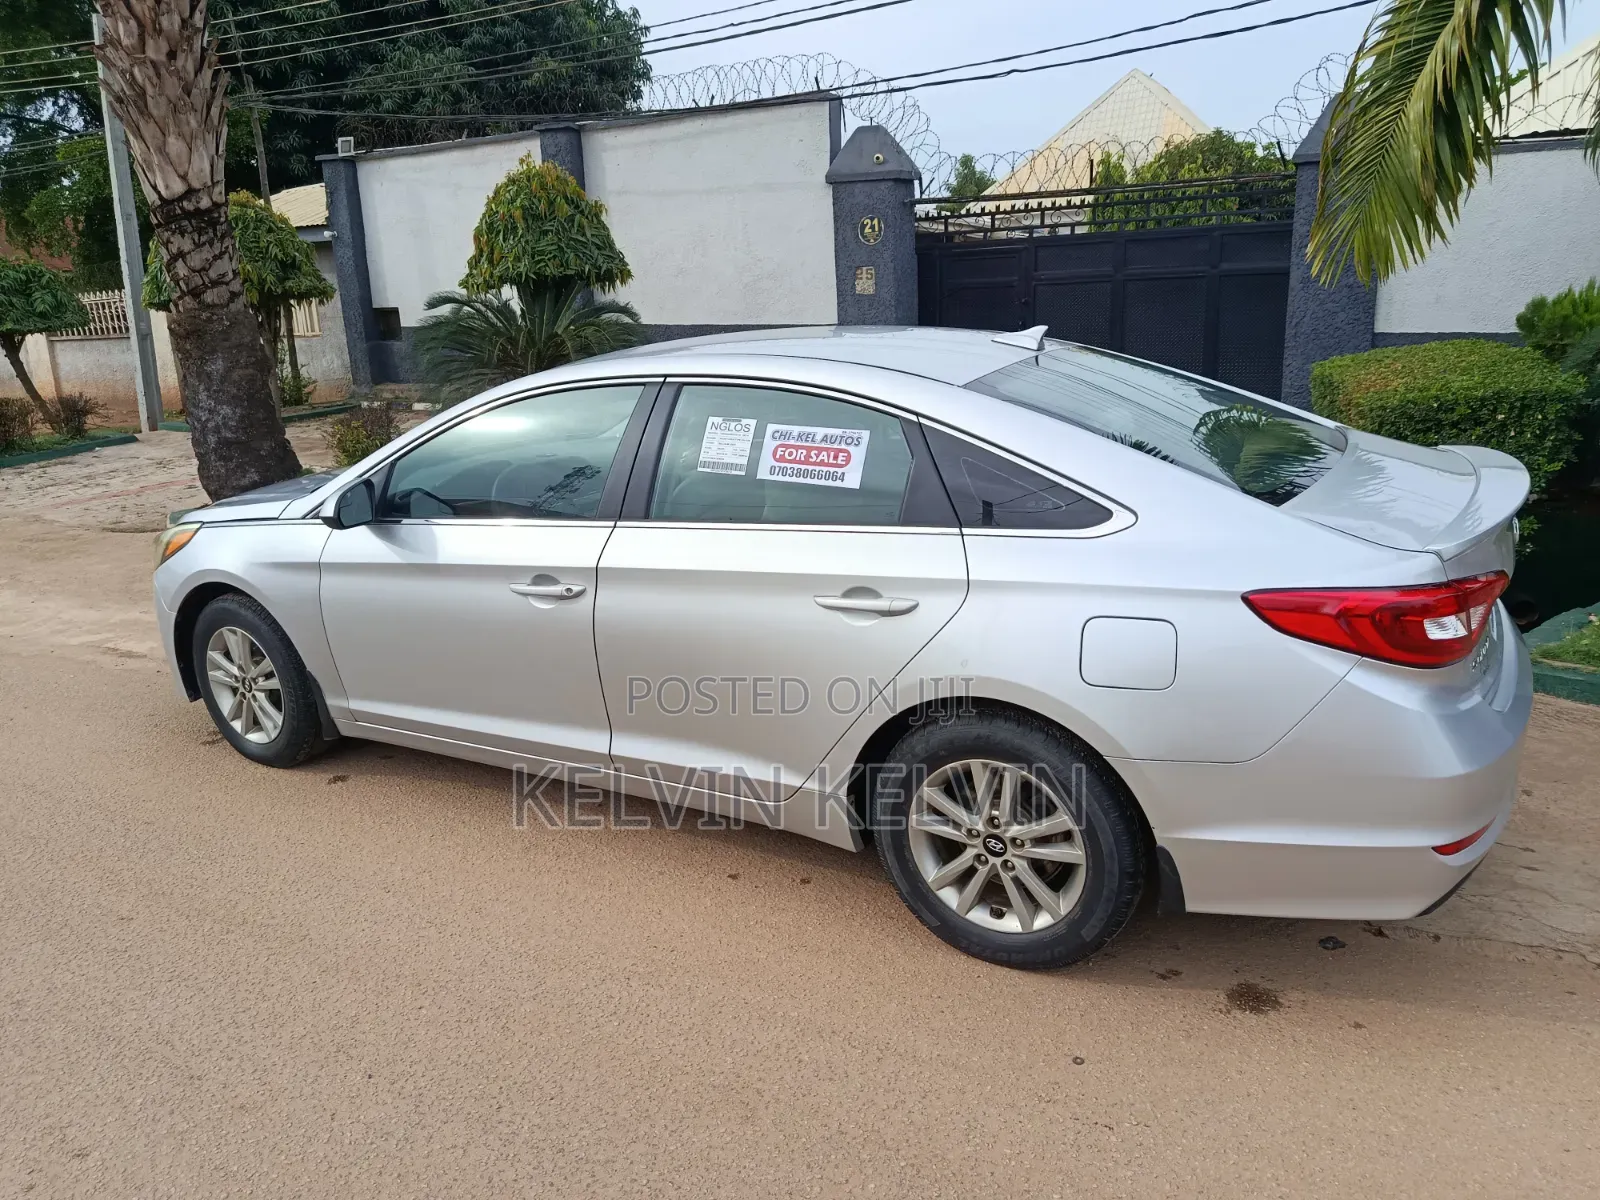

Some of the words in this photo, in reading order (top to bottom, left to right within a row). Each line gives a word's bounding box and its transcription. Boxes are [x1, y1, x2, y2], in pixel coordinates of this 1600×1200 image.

[864, 217, 879, 233] 21
[710, 421, 751, 432] NGLOS
[771, 430, 818, 443] CHI-KEL
[820, 433, 862, 446] AUTOS
[775, 447, 807, 461] FOR
[809, 450, 848, 464] SALE
[769, 465, 846, 482] 07038066064
